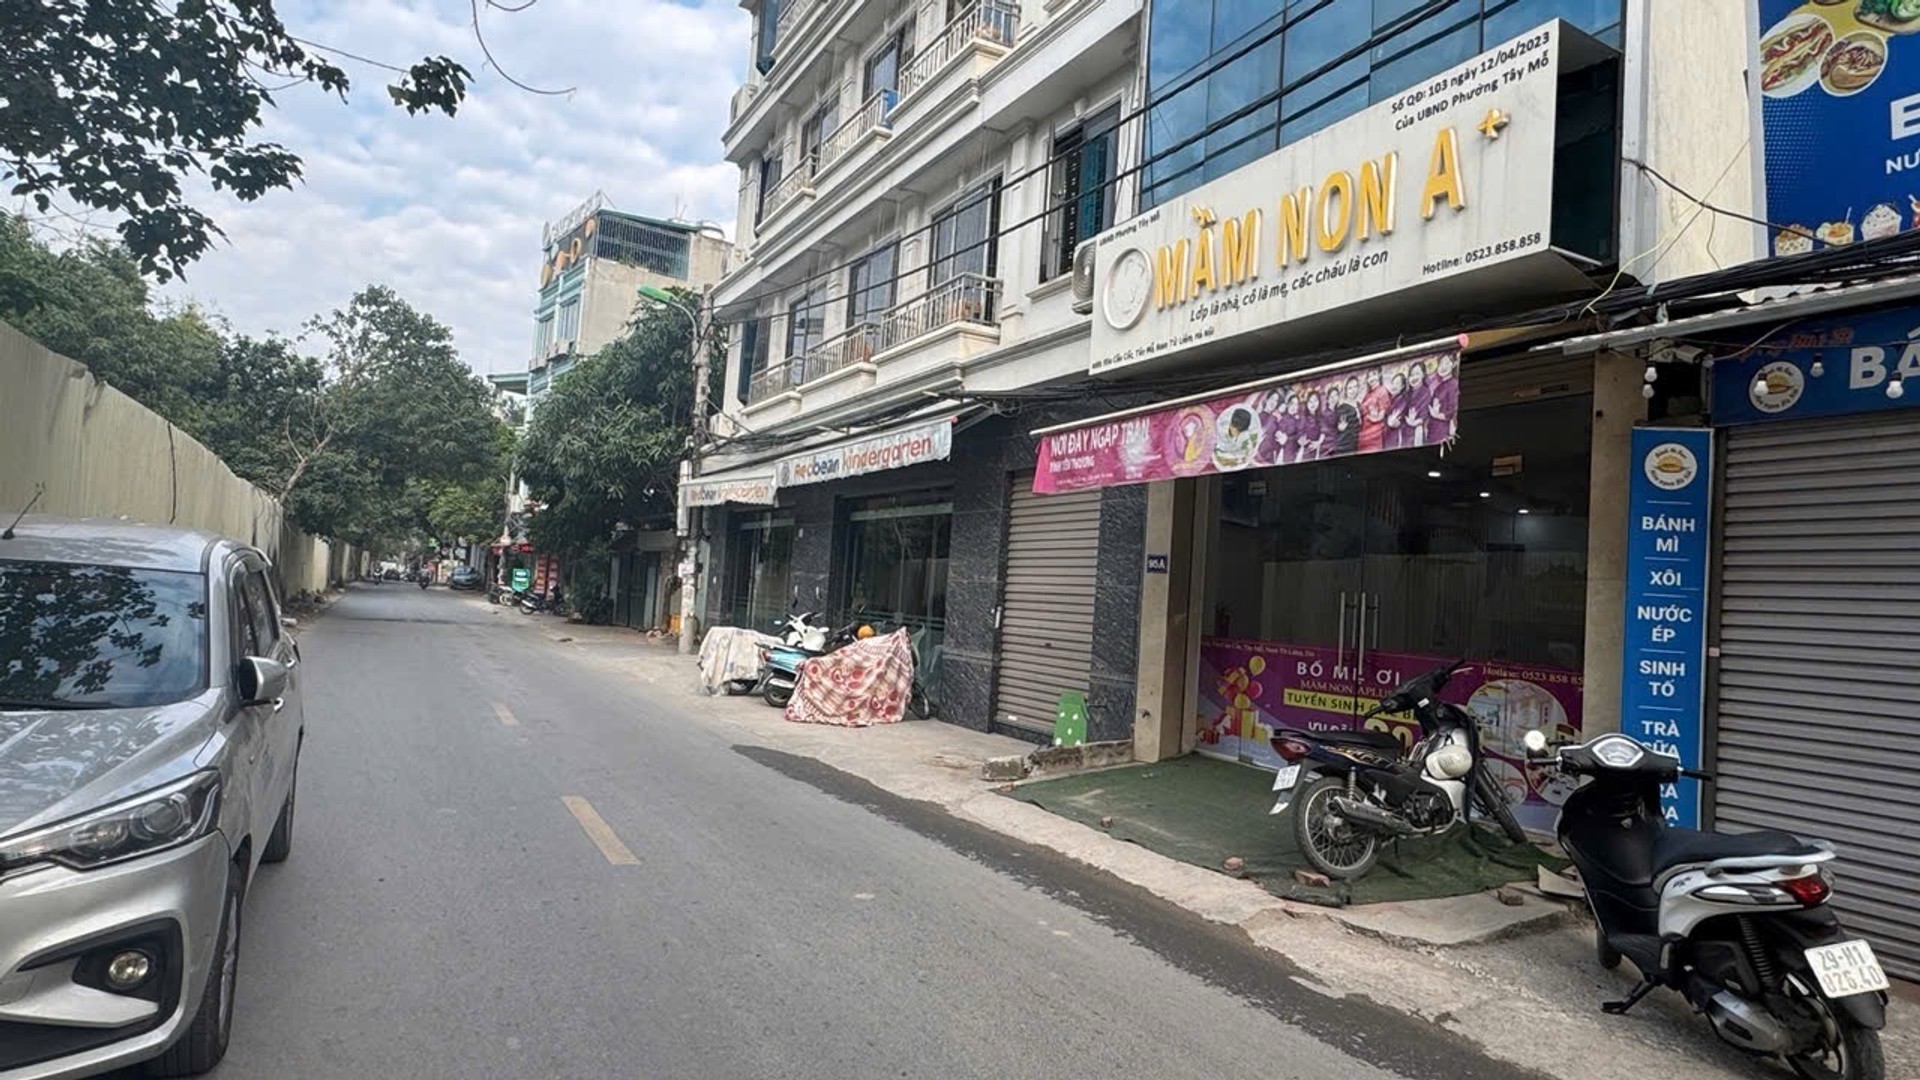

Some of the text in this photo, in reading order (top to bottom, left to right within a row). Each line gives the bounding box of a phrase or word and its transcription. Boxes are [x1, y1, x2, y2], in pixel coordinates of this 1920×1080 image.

[1429, 80, 1448, 97] 103
[1480, 31, 1550, 74] 12/04/2023
[1394, 50, 1550, 131] Của UBND Phường Tây Mỗ
[1153, 204, 1262, 312] MẦM
[1277, 150, 1399, 269] NON
[1315, 259, 1347, 284] cháu
[1347, 254, 1361, 273] là
[1362, 249, 1389, 269] con
[1422, 256, 1462, 276] Hotline:
[1641, 513, 1695, 533] BÁNH
[1655, 535, 1679, 553] MÌ
[1649, 568, 1682, 587] XÔI
[1636, 604, 1693, 623] NƯỚC
[1651, 623, 1676, 643] ÉP
[1297, 659, 1323, 678] BỐ
[1376, 668, 1400, 686] ƠI
[1522, 670, 1547, 681] 0523
[1639, 659, 1686, 677] SINH
[1648, 678, 1676, 697] TỐ
[1330, 698, 1365, 712] SINH
[1641, 718, 1681, 738] TRÀ
